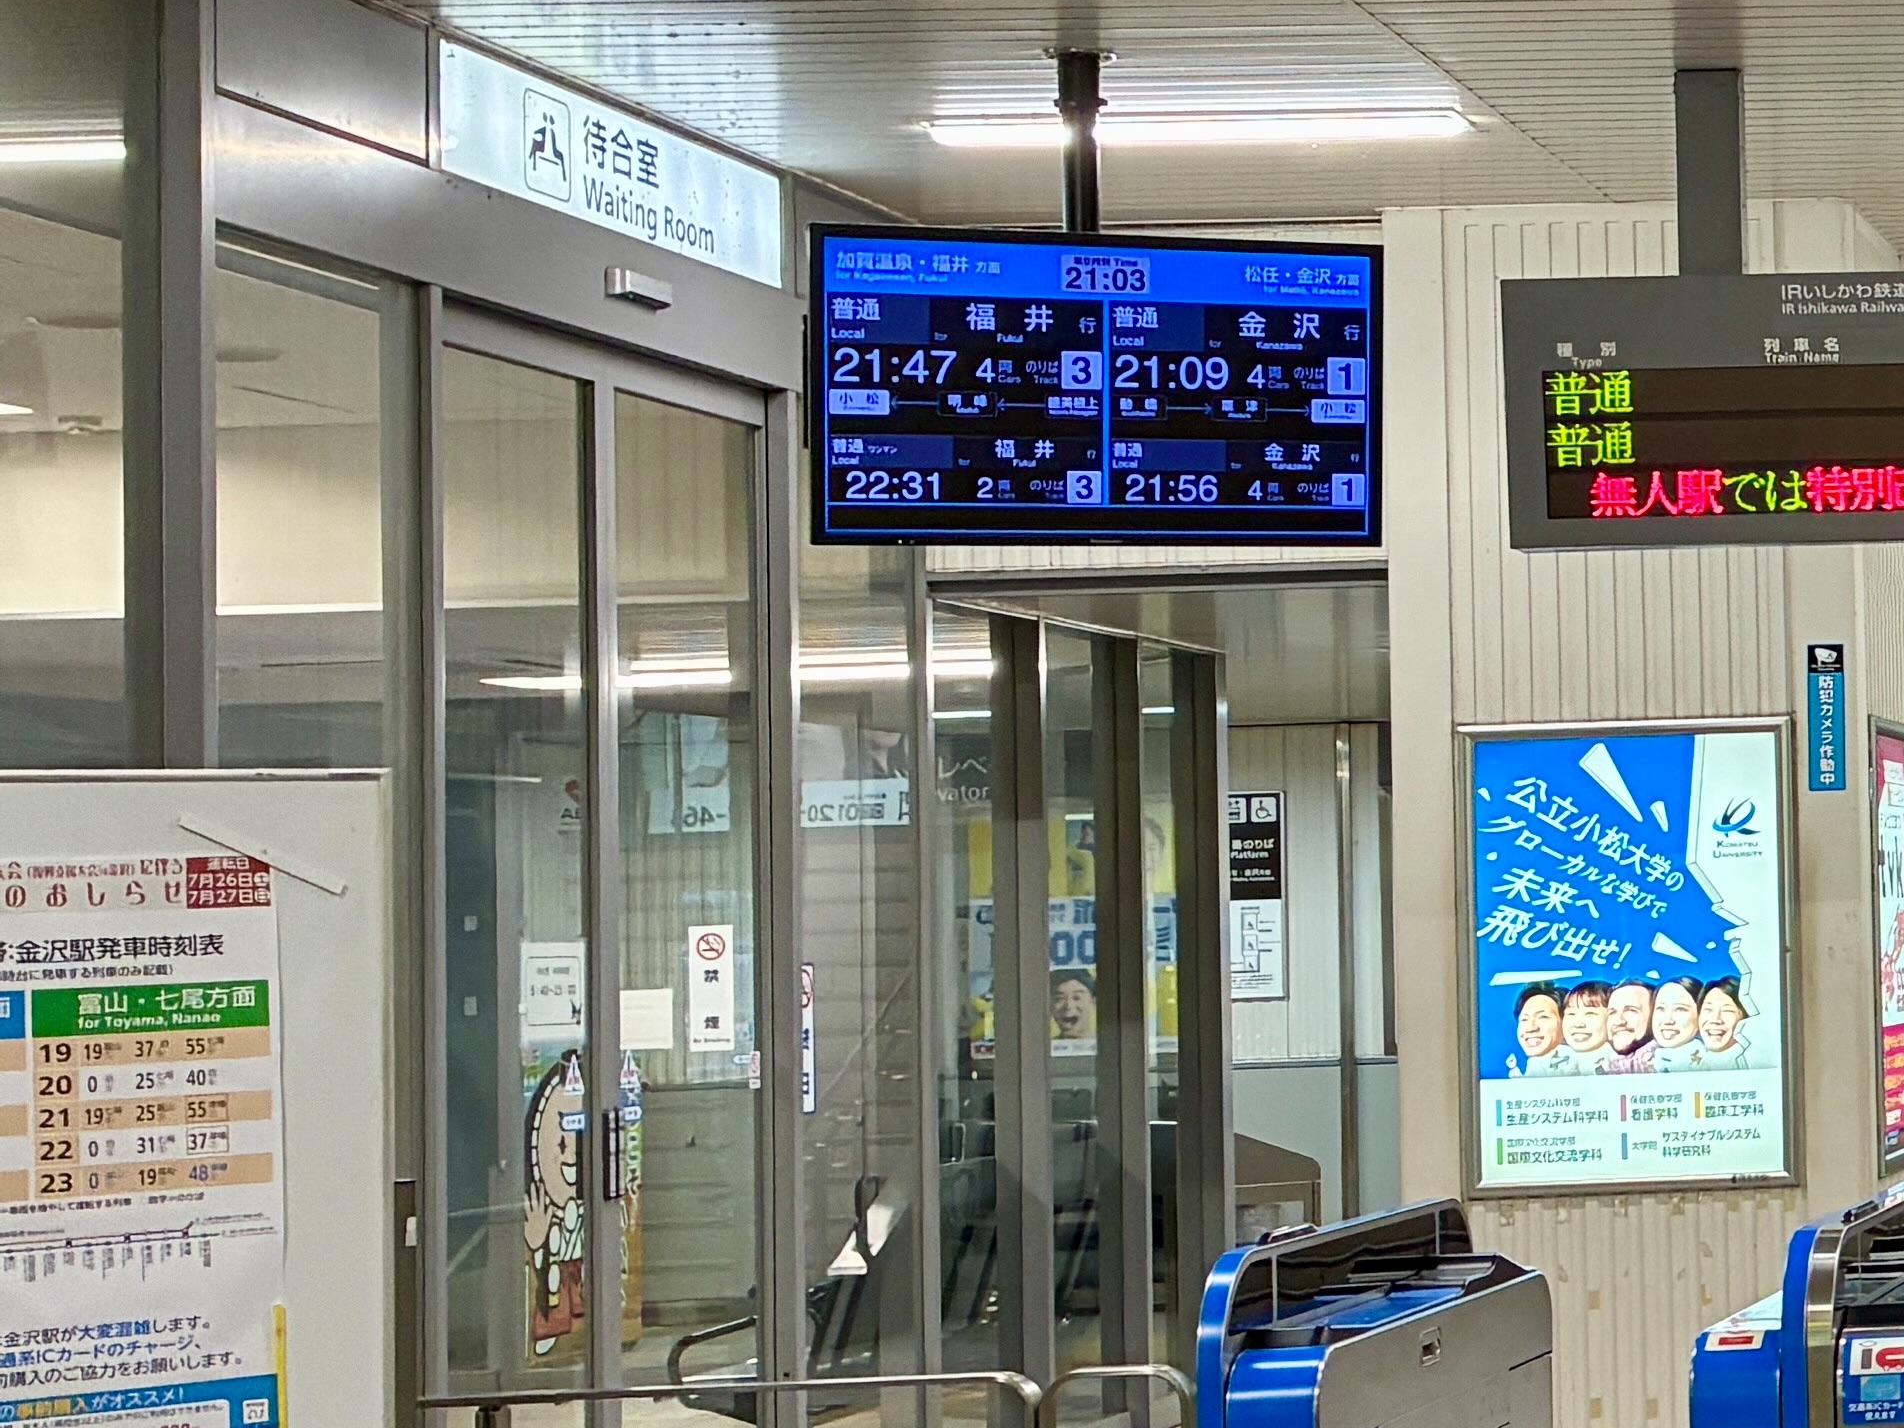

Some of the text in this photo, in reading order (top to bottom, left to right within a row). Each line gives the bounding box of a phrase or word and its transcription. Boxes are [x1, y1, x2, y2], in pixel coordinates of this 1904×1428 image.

[583, 115, 661, 189] 待合室
[583, 174, 716, 254] Waiting Room
[1065, 267, 1146, 292] 21:03
[831, 298, 880, 321] 普通
[1113, 307, 1158, 329] 普通
[831, 327, 865, 339] Local
[1113, 335, 1144, 347] Local
[833, 347, 957, 384] 21:47
[976, 358, 996, 383] 4
[1071, 356, 1092, 384] 3
[1115, 355, 1229, 390] 21:09
[1247, 364, 1266, 388] 4
[1546, 371, 1633, 416] 普通
[1547, 421, 1635, 467] 普通
[845, 471, 941, 501] 22:31
[1125, 475, 1218, 503] 21:56
[1817, 675, 1836, 786] 防犯カメラ作動中
[1505, 777, 1685, 893] 公立小松大学の
[1478, 815, 1668, 919] グローカルな学びで
[1492, 867, 1601, 919] 未来へ
[40, 1044, 72, 1064] 19
[40, 1077, 72, 1097] 20
[40, 1109, 72, 1129] 21
[40, 1142, 73, 1162] 22
[41, 1174, 74, 1195] 23
